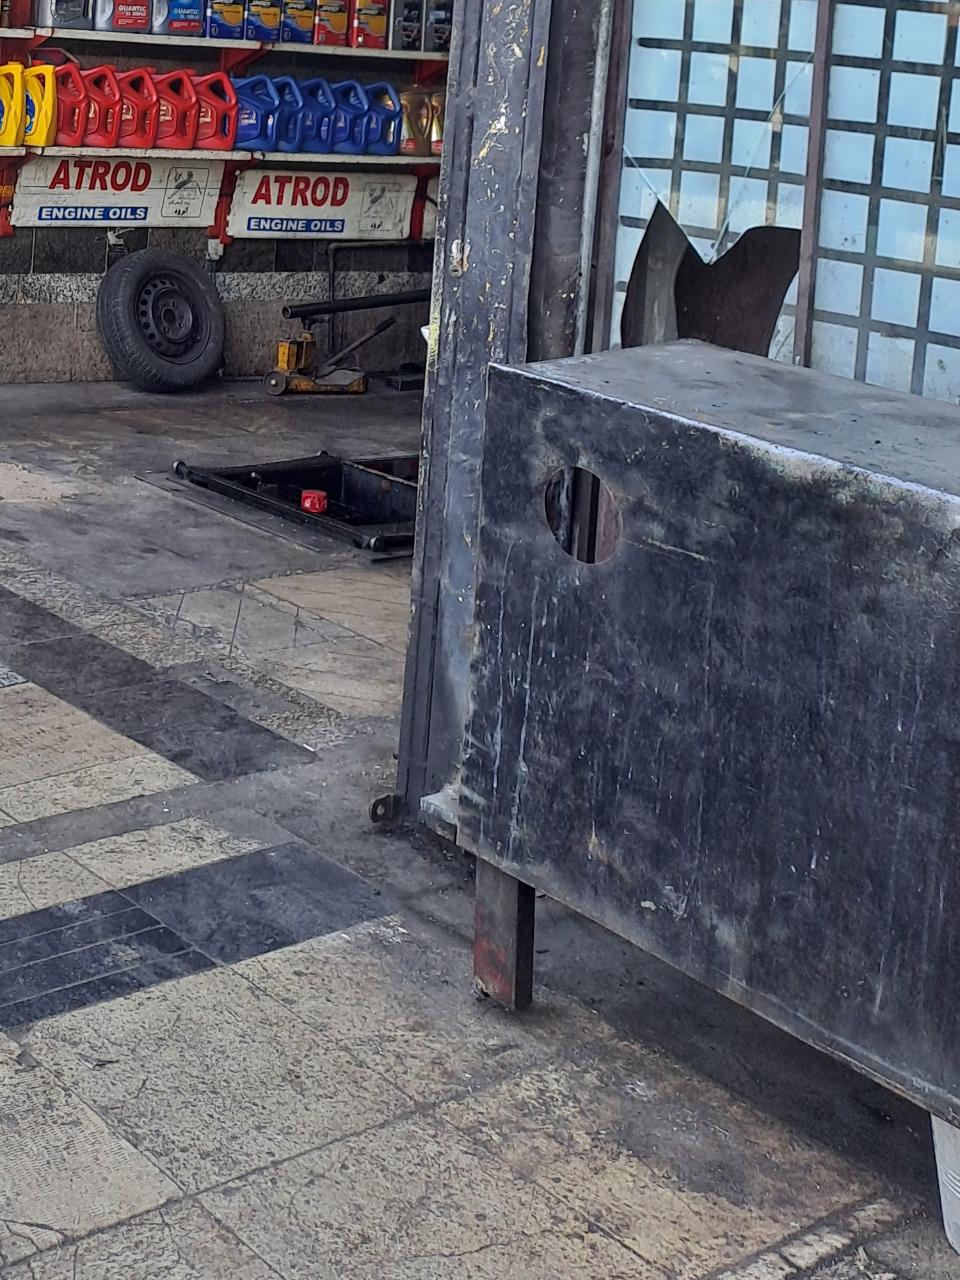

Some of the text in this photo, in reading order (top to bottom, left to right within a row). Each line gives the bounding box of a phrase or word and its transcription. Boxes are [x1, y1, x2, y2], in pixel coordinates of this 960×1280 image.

[118, 4, 147, 12] QUANTIC
[48, 159, 152, 192] ATROD
[251, 175, 350, 207] ATROD
[41, 207, 146, 220] ENGINE OILS
[249, 218, 343, 232] ENGINE OILS
